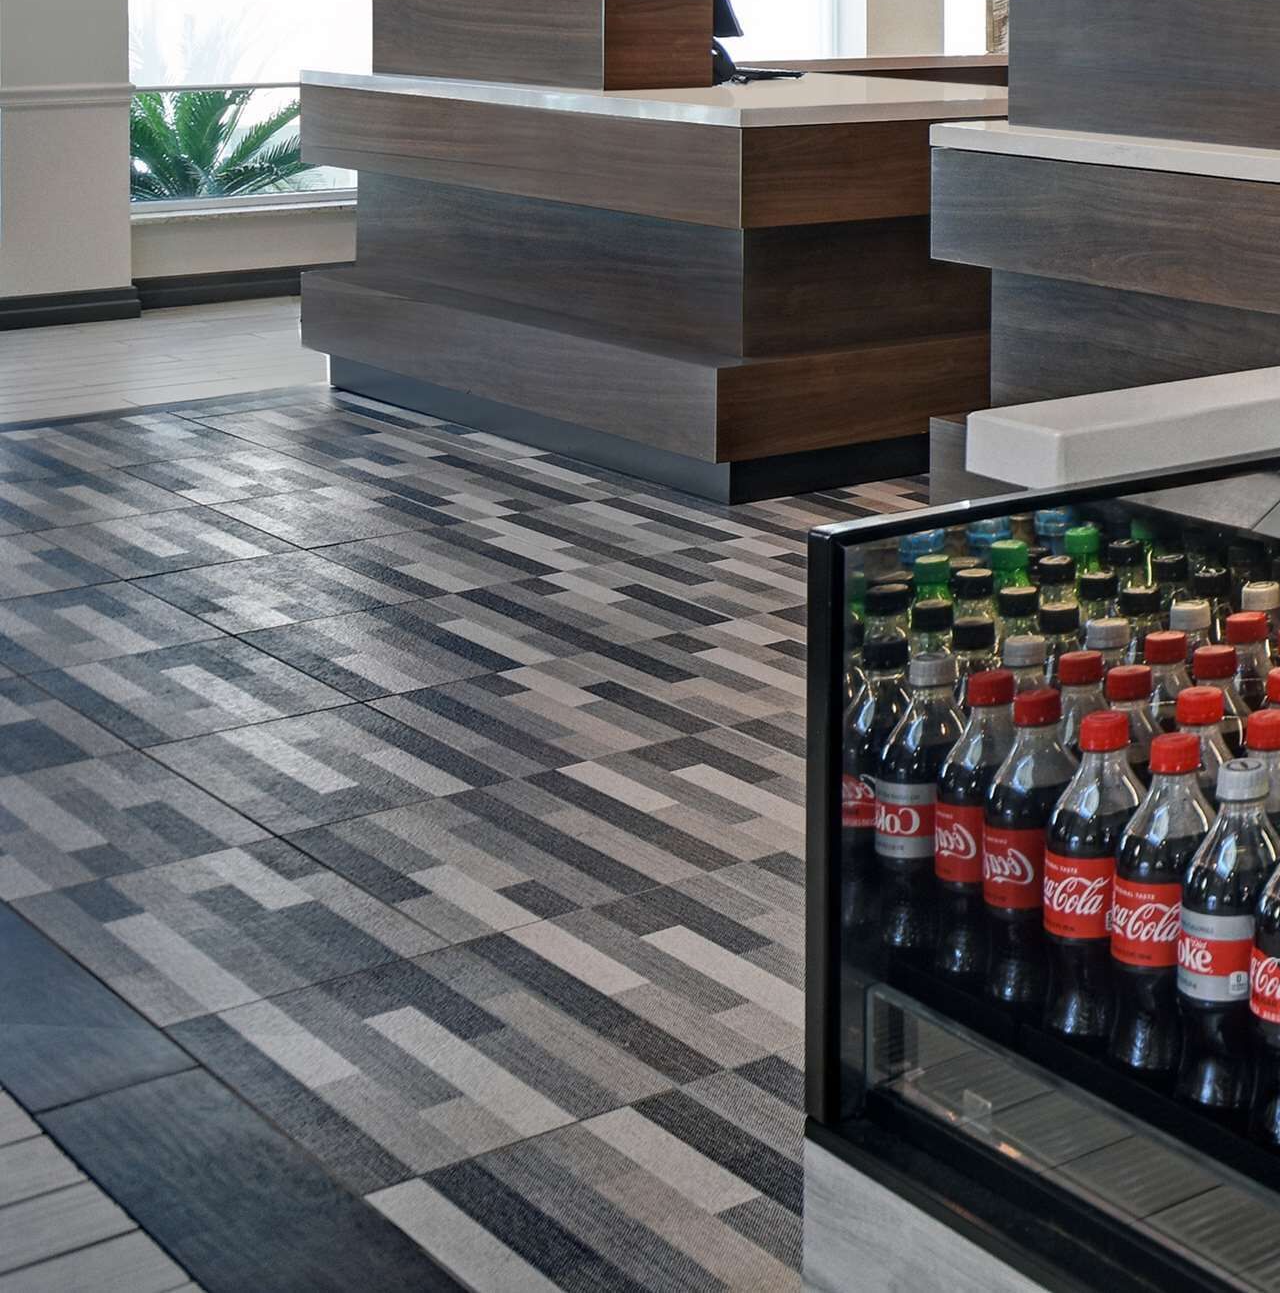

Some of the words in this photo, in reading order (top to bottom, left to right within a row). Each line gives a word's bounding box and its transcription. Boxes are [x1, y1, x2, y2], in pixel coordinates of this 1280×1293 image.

[1044, 876, 1111, 915] a-Cola
[1112, 902, 1182, 943] ca-Cola
[1177, 936, 1212, 973] oke
